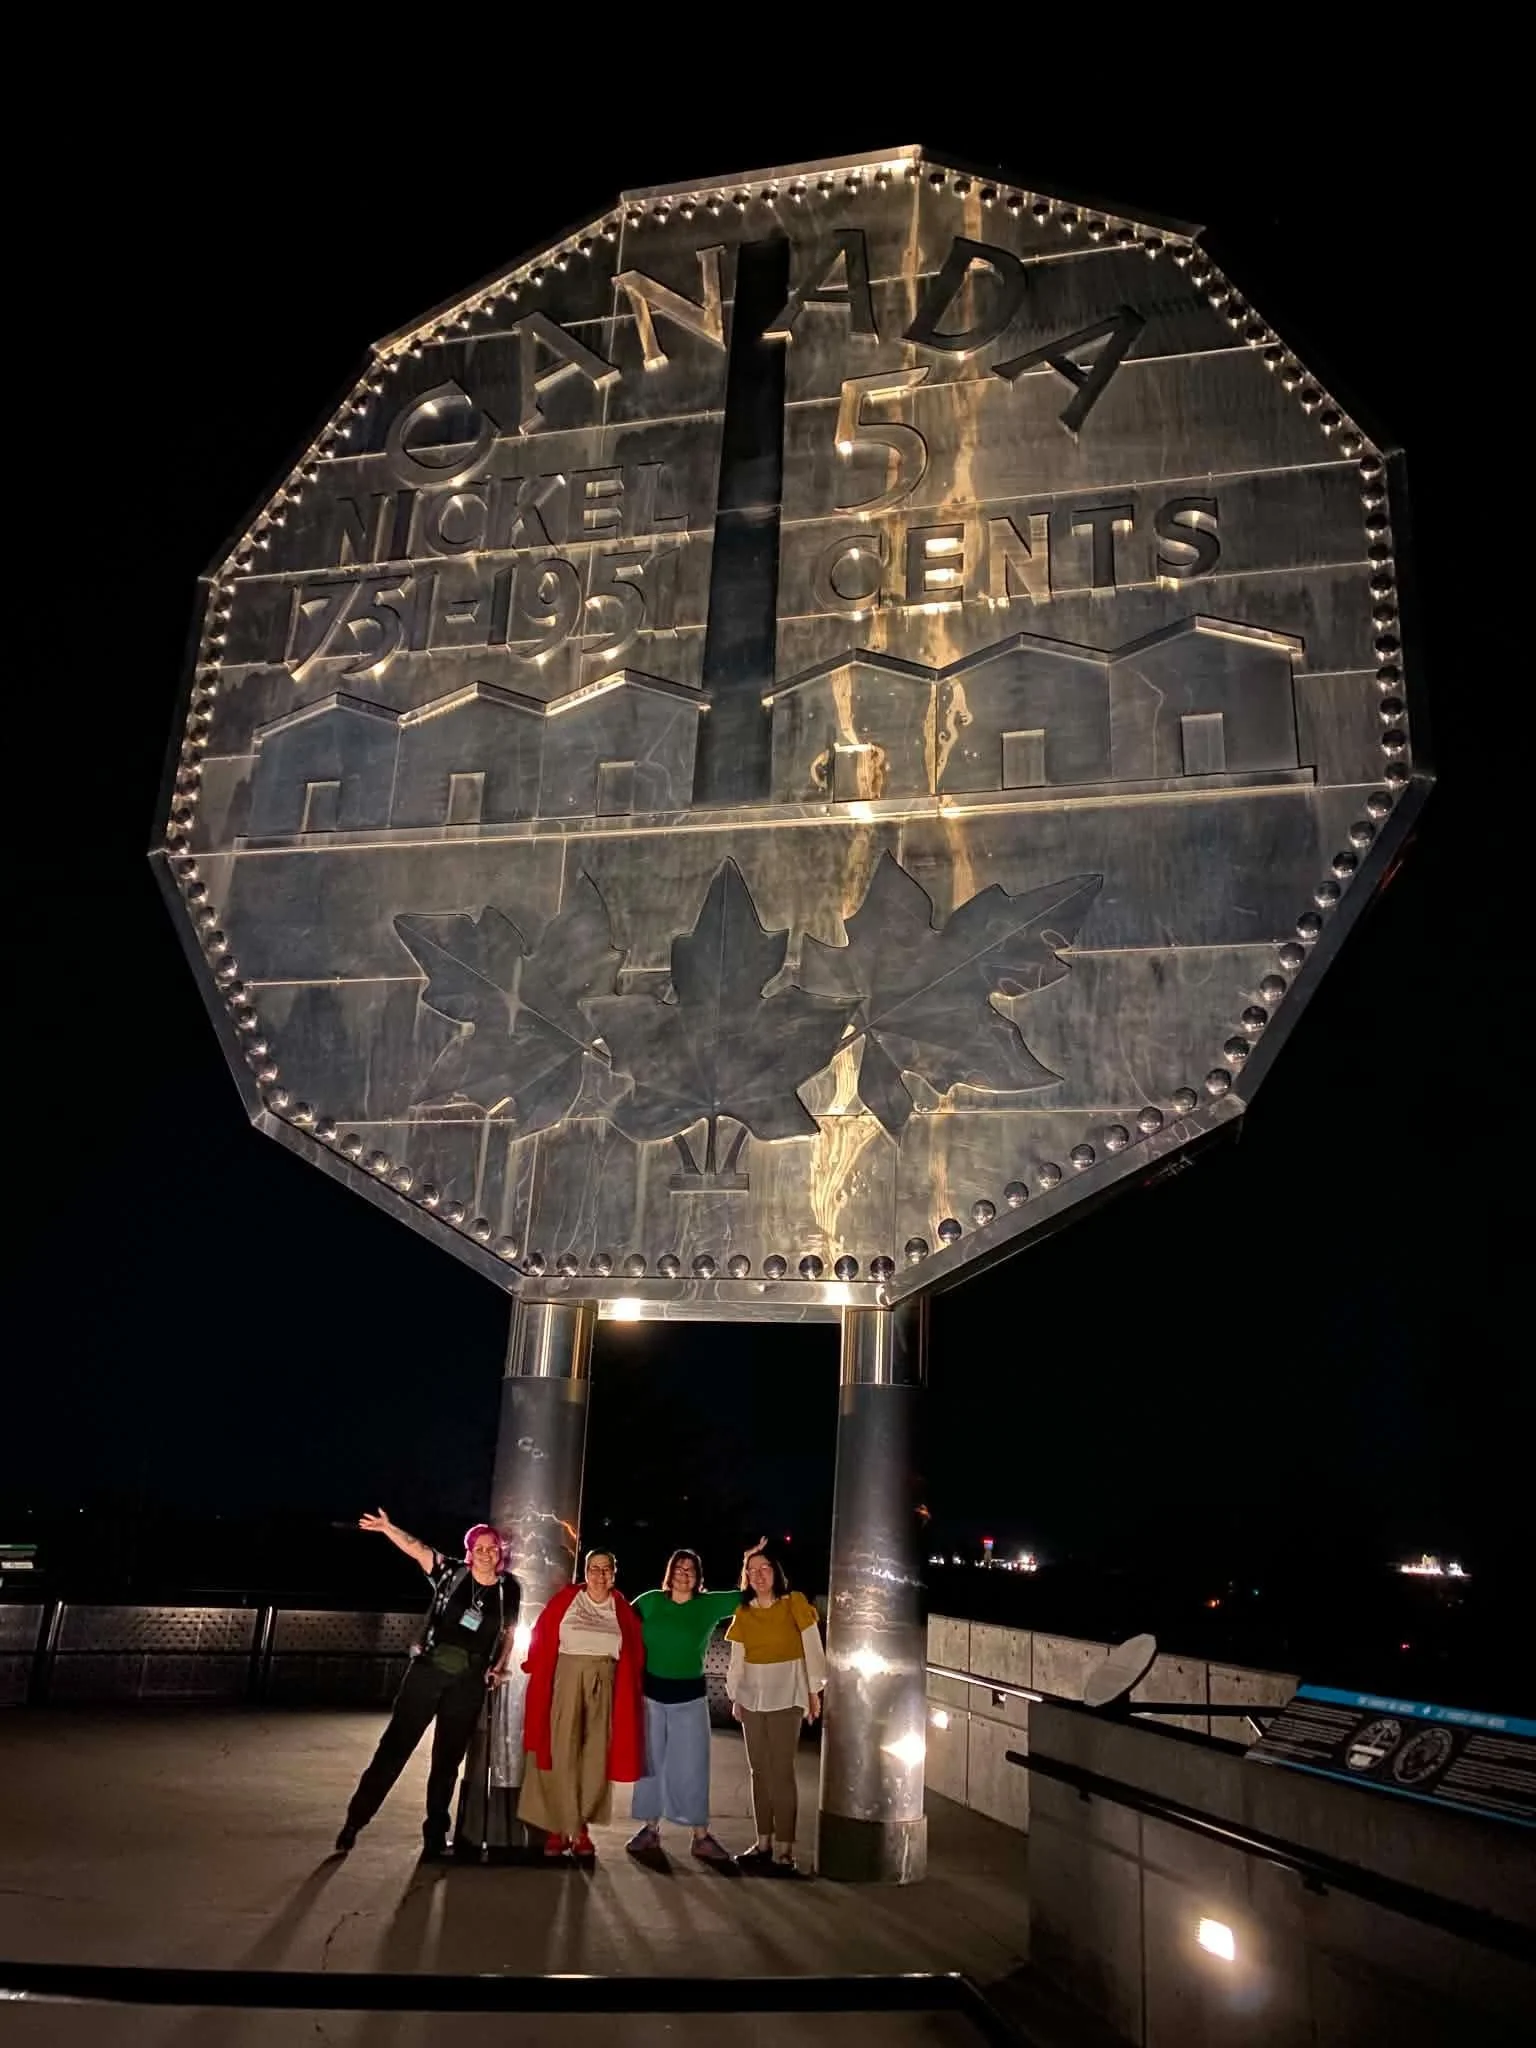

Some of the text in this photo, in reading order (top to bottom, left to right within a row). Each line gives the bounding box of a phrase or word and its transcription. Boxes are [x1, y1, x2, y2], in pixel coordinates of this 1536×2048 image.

[386, 229, 1147, 488] CANADA
[835, 366, 930, 520] 5
[335, 462, 690, 568] NICKEL
[813, 497, 1222, 620] CENTS
